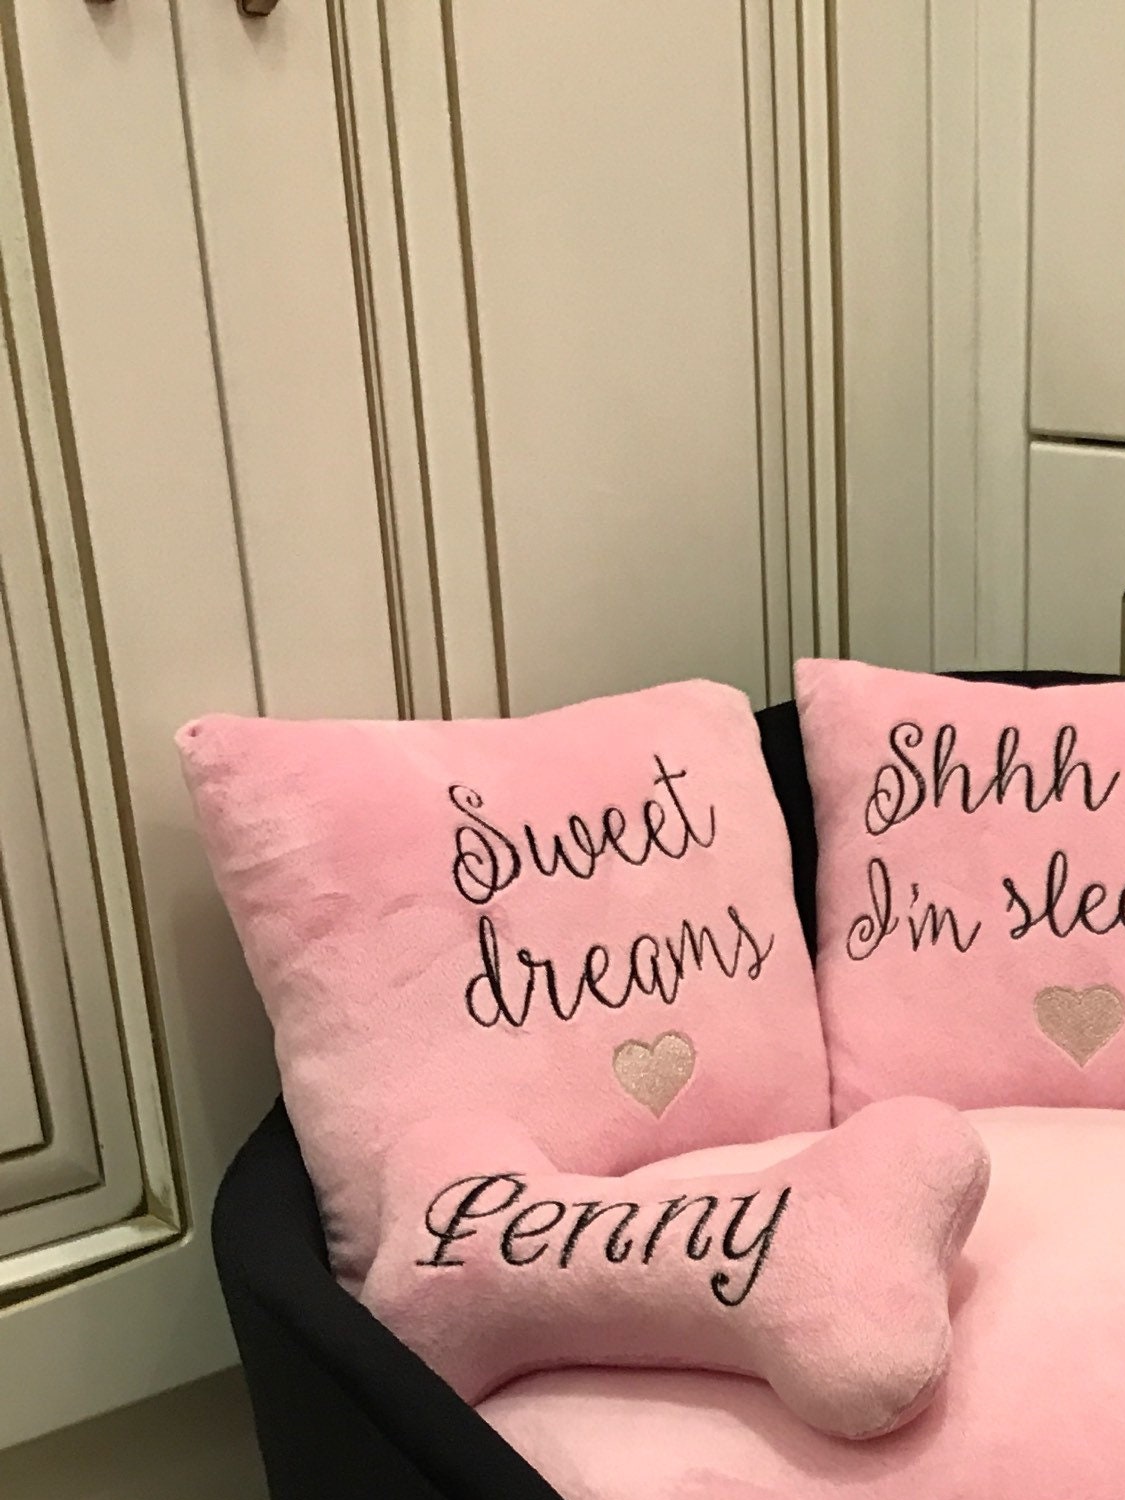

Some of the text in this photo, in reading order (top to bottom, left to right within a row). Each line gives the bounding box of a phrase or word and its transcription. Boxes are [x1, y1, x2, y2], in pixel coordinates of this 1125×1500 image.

[448, 754, 715, 905] Sweet
[865, 721, 1120, 836] Shhh
[465, 905, 775, 1028] dreams
[846, 857, 982, 961] I'm
[415, 1172, 792, 1307] Penny
